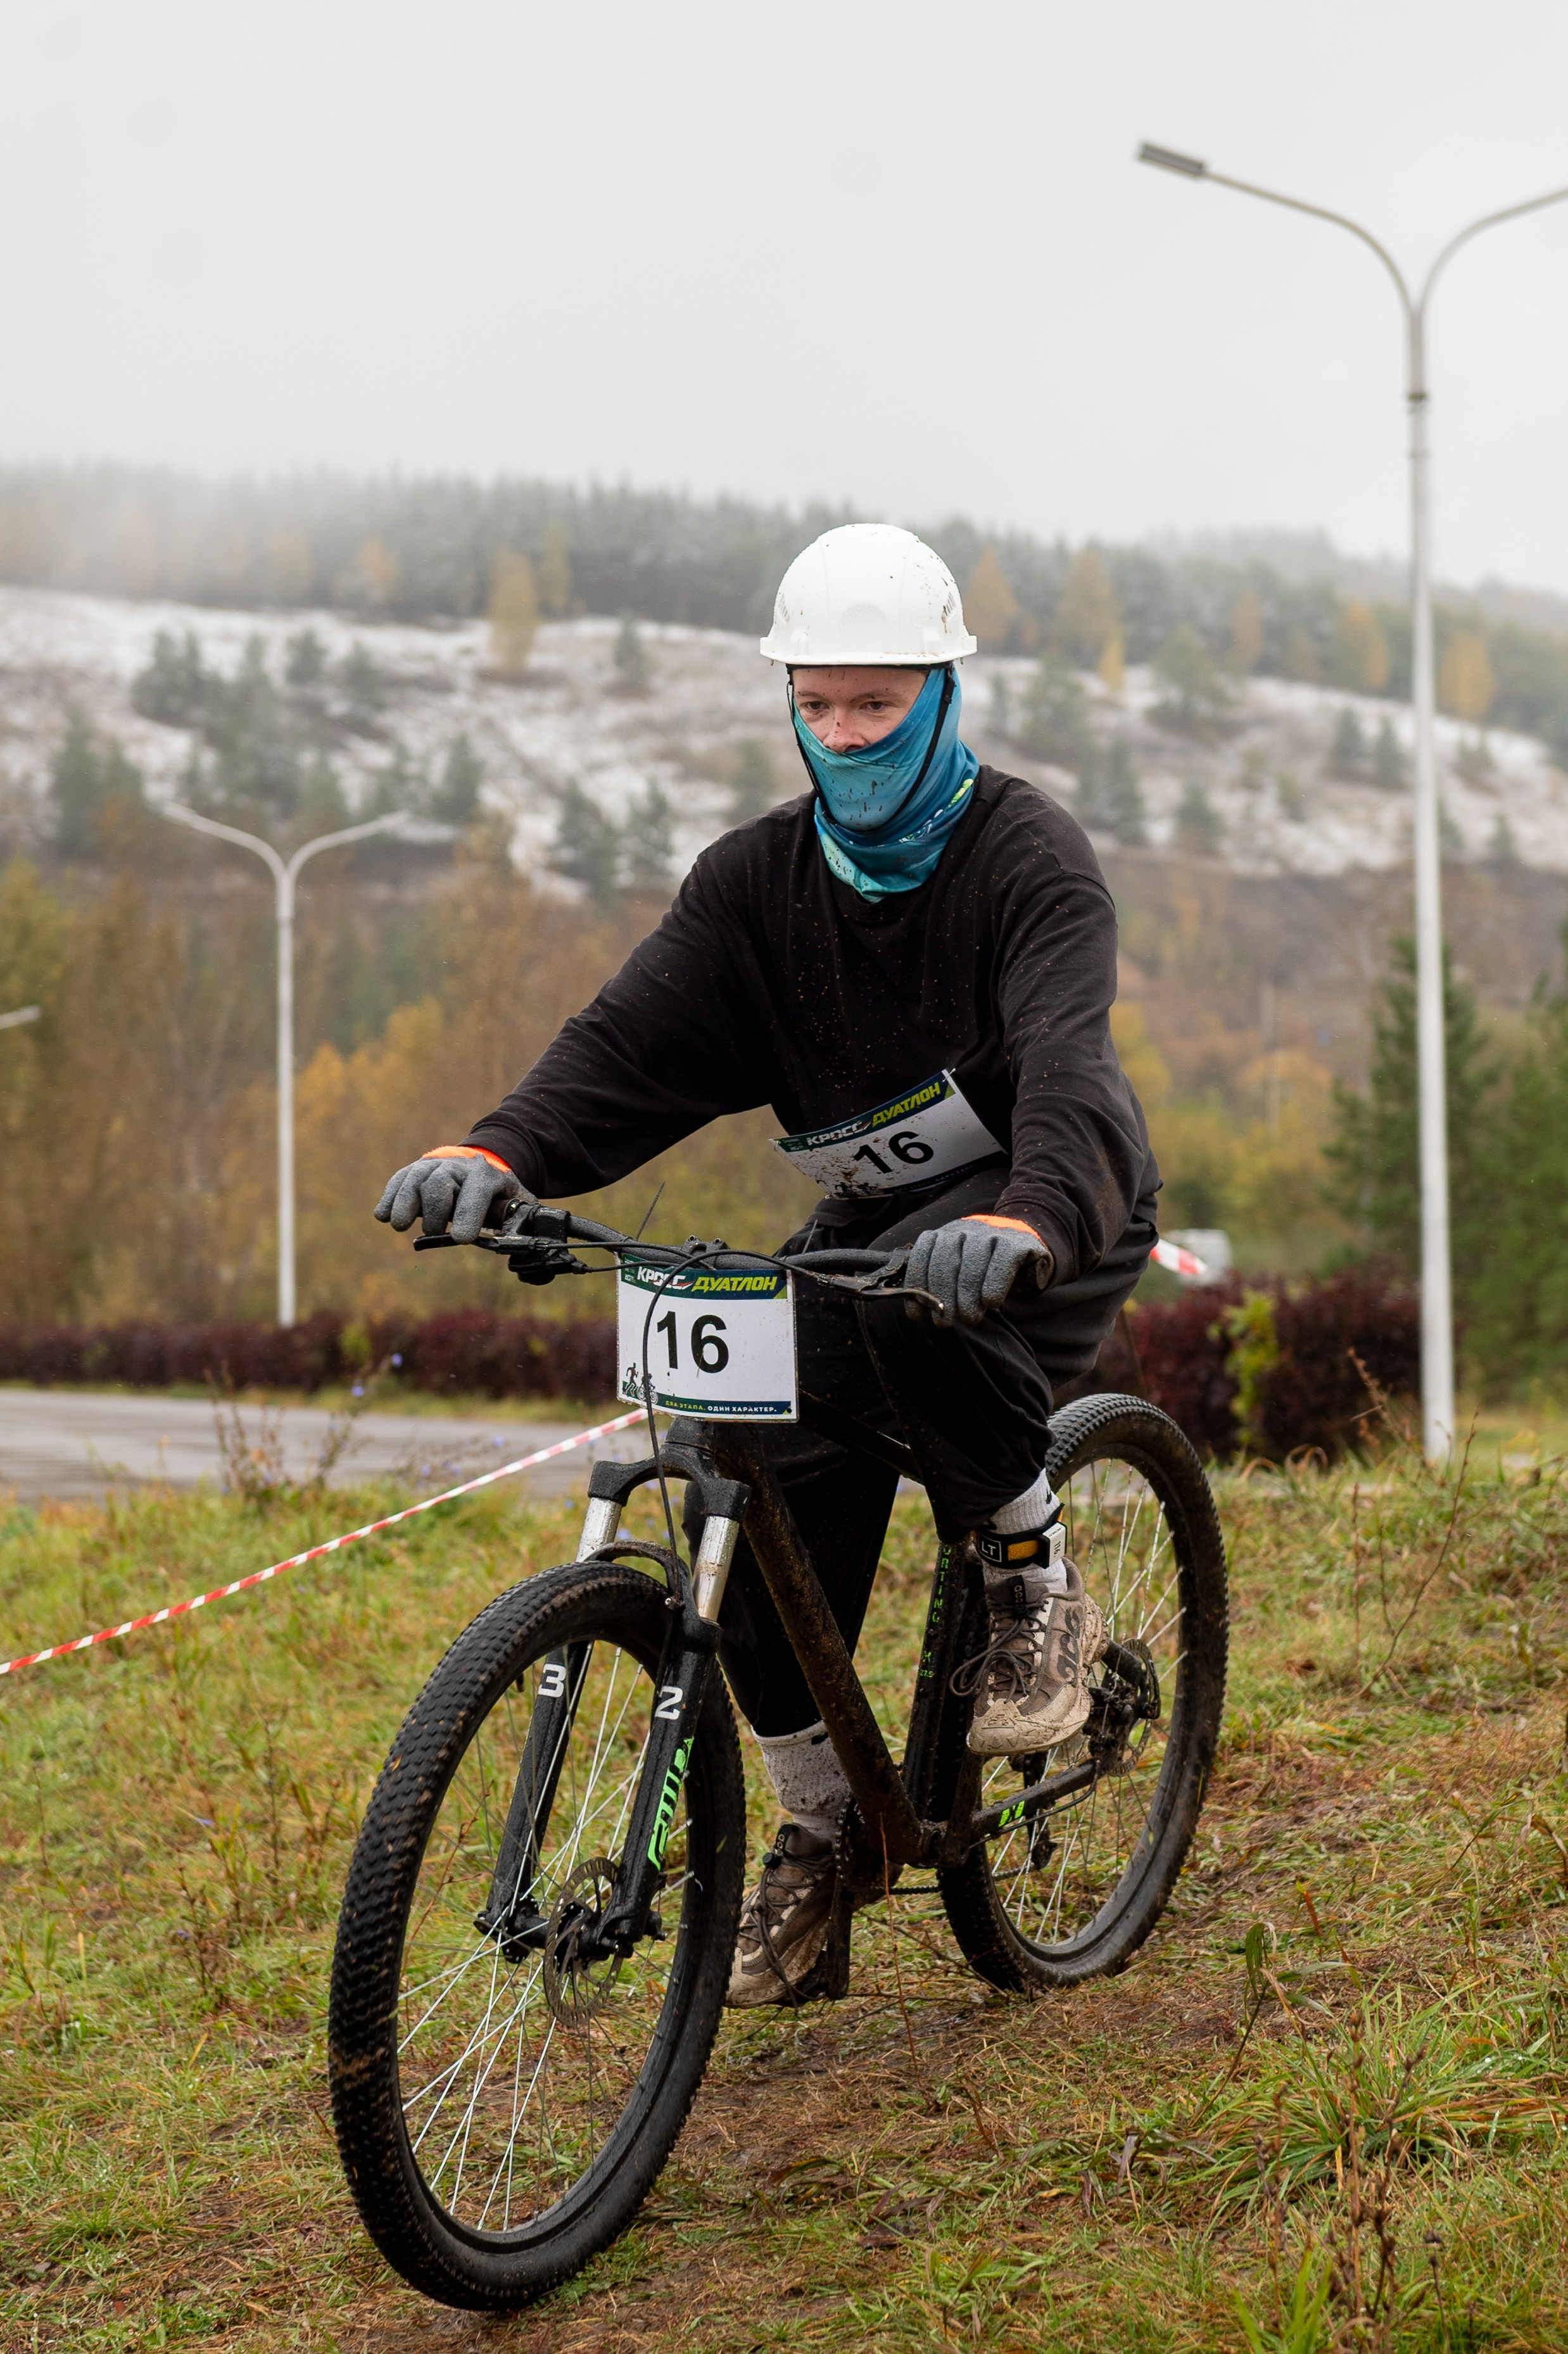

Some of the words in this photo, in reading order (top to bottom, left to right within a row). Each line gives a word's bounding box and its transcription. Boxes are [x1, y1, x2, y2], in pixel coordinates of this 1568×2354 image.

[873, 1082, 940, 1127] ДУАТЛОН
[853, 1131, 933, 1174] 16
[692, 1277, 777, 1293] ДУАТЛОН
[657, 1310, 729, 1374] 16
[982, 1541, 996, 1556] LT
